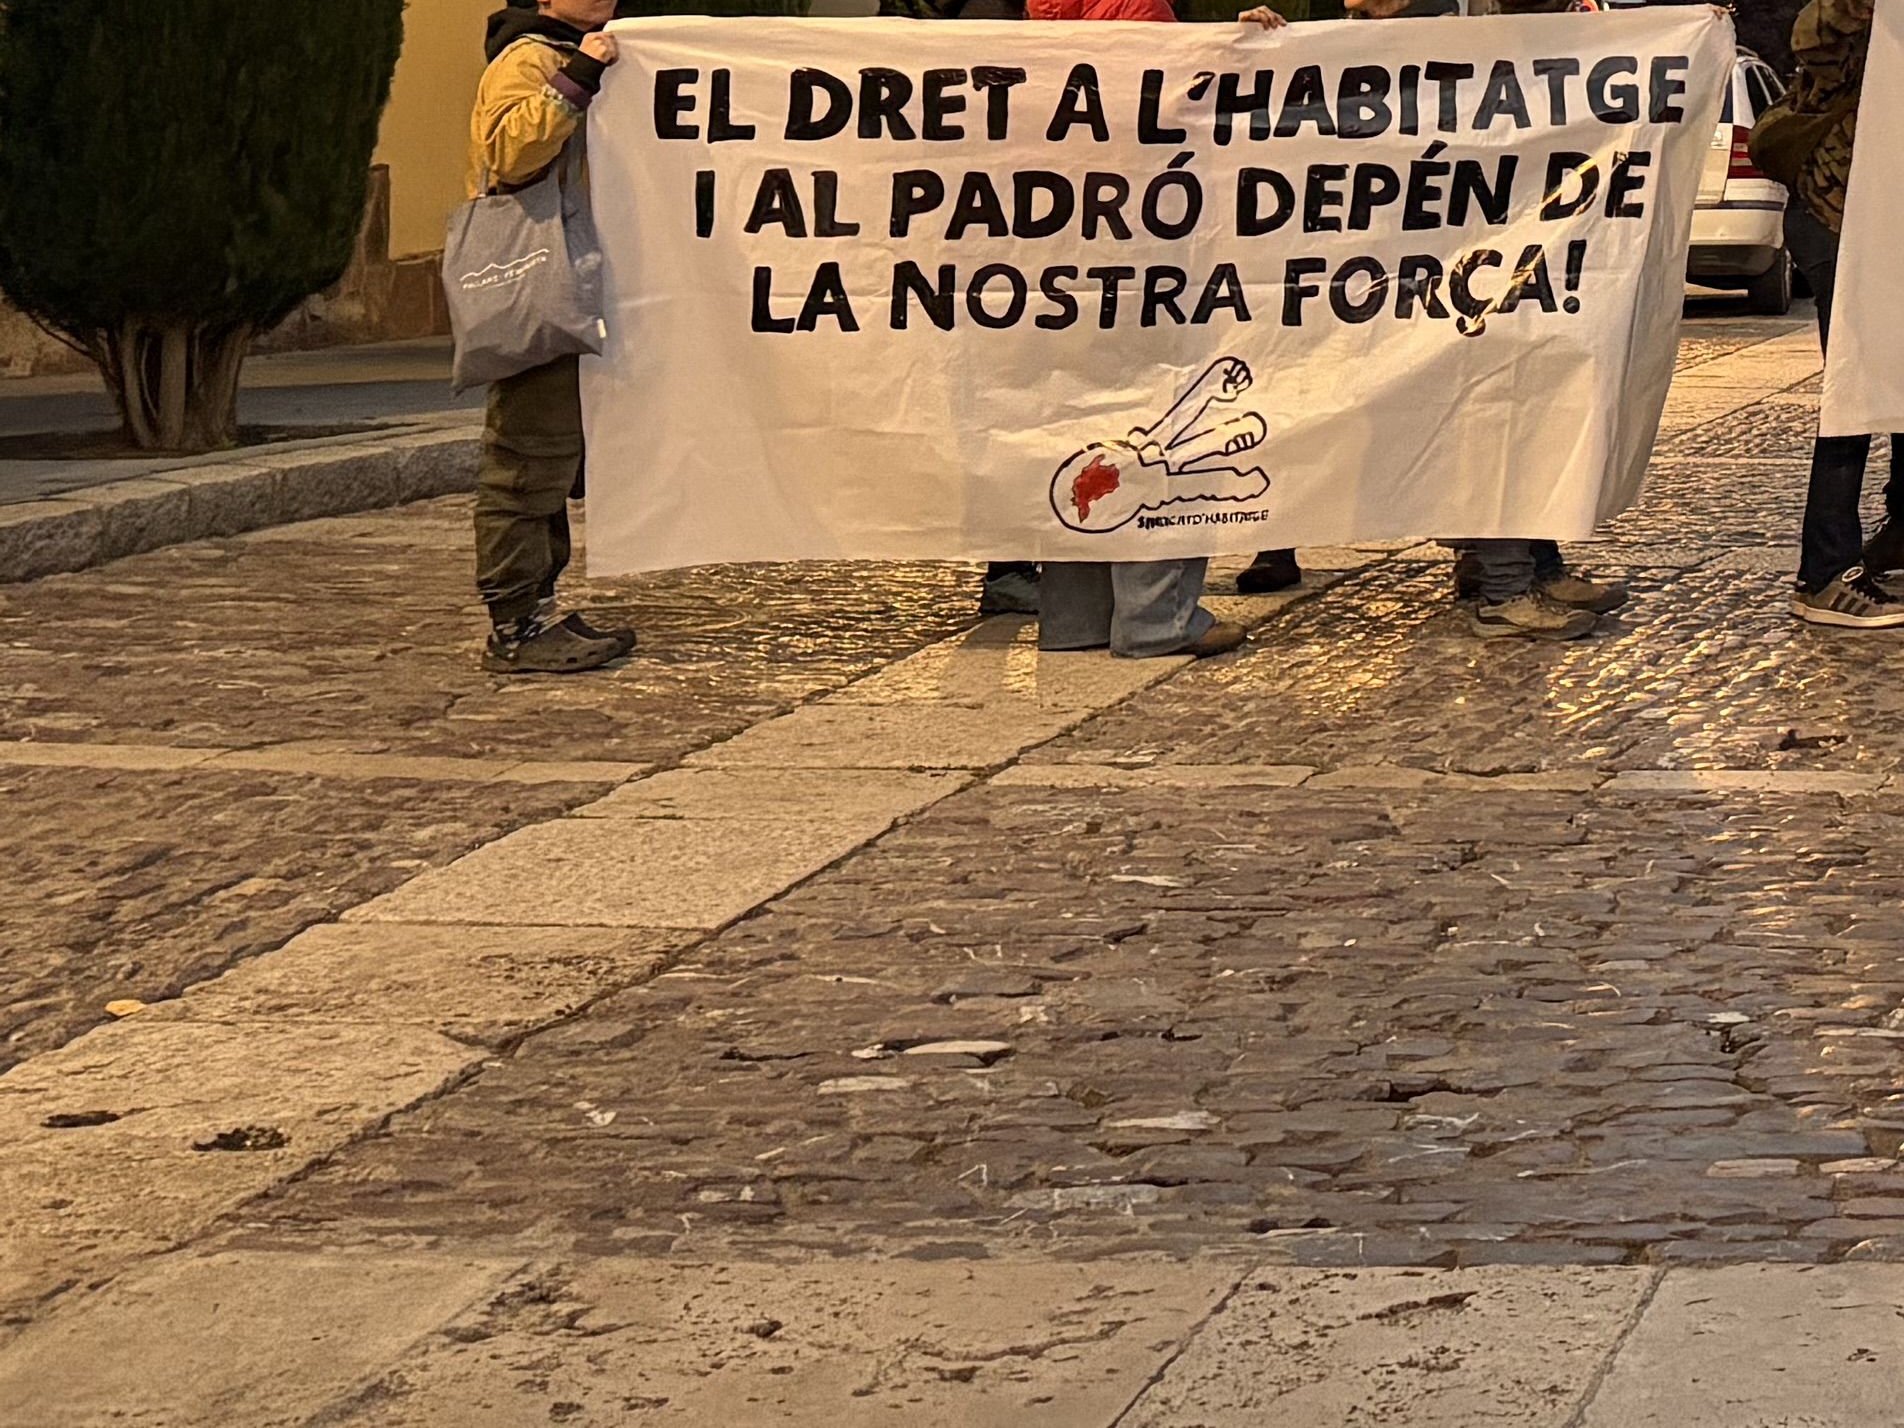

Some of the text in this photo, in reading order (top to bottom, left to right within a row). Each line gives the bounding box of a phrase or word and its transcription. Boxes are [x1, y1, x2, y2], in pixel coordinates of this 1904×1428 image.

[654, 56, 1688, 146] EL DRET A L'HABITATGE
[696, 140, 1651, 240] I AL PADRÓ DEPÉN DE
[752, 239, 1586, 337] LA NOSTRA FORÇA!
